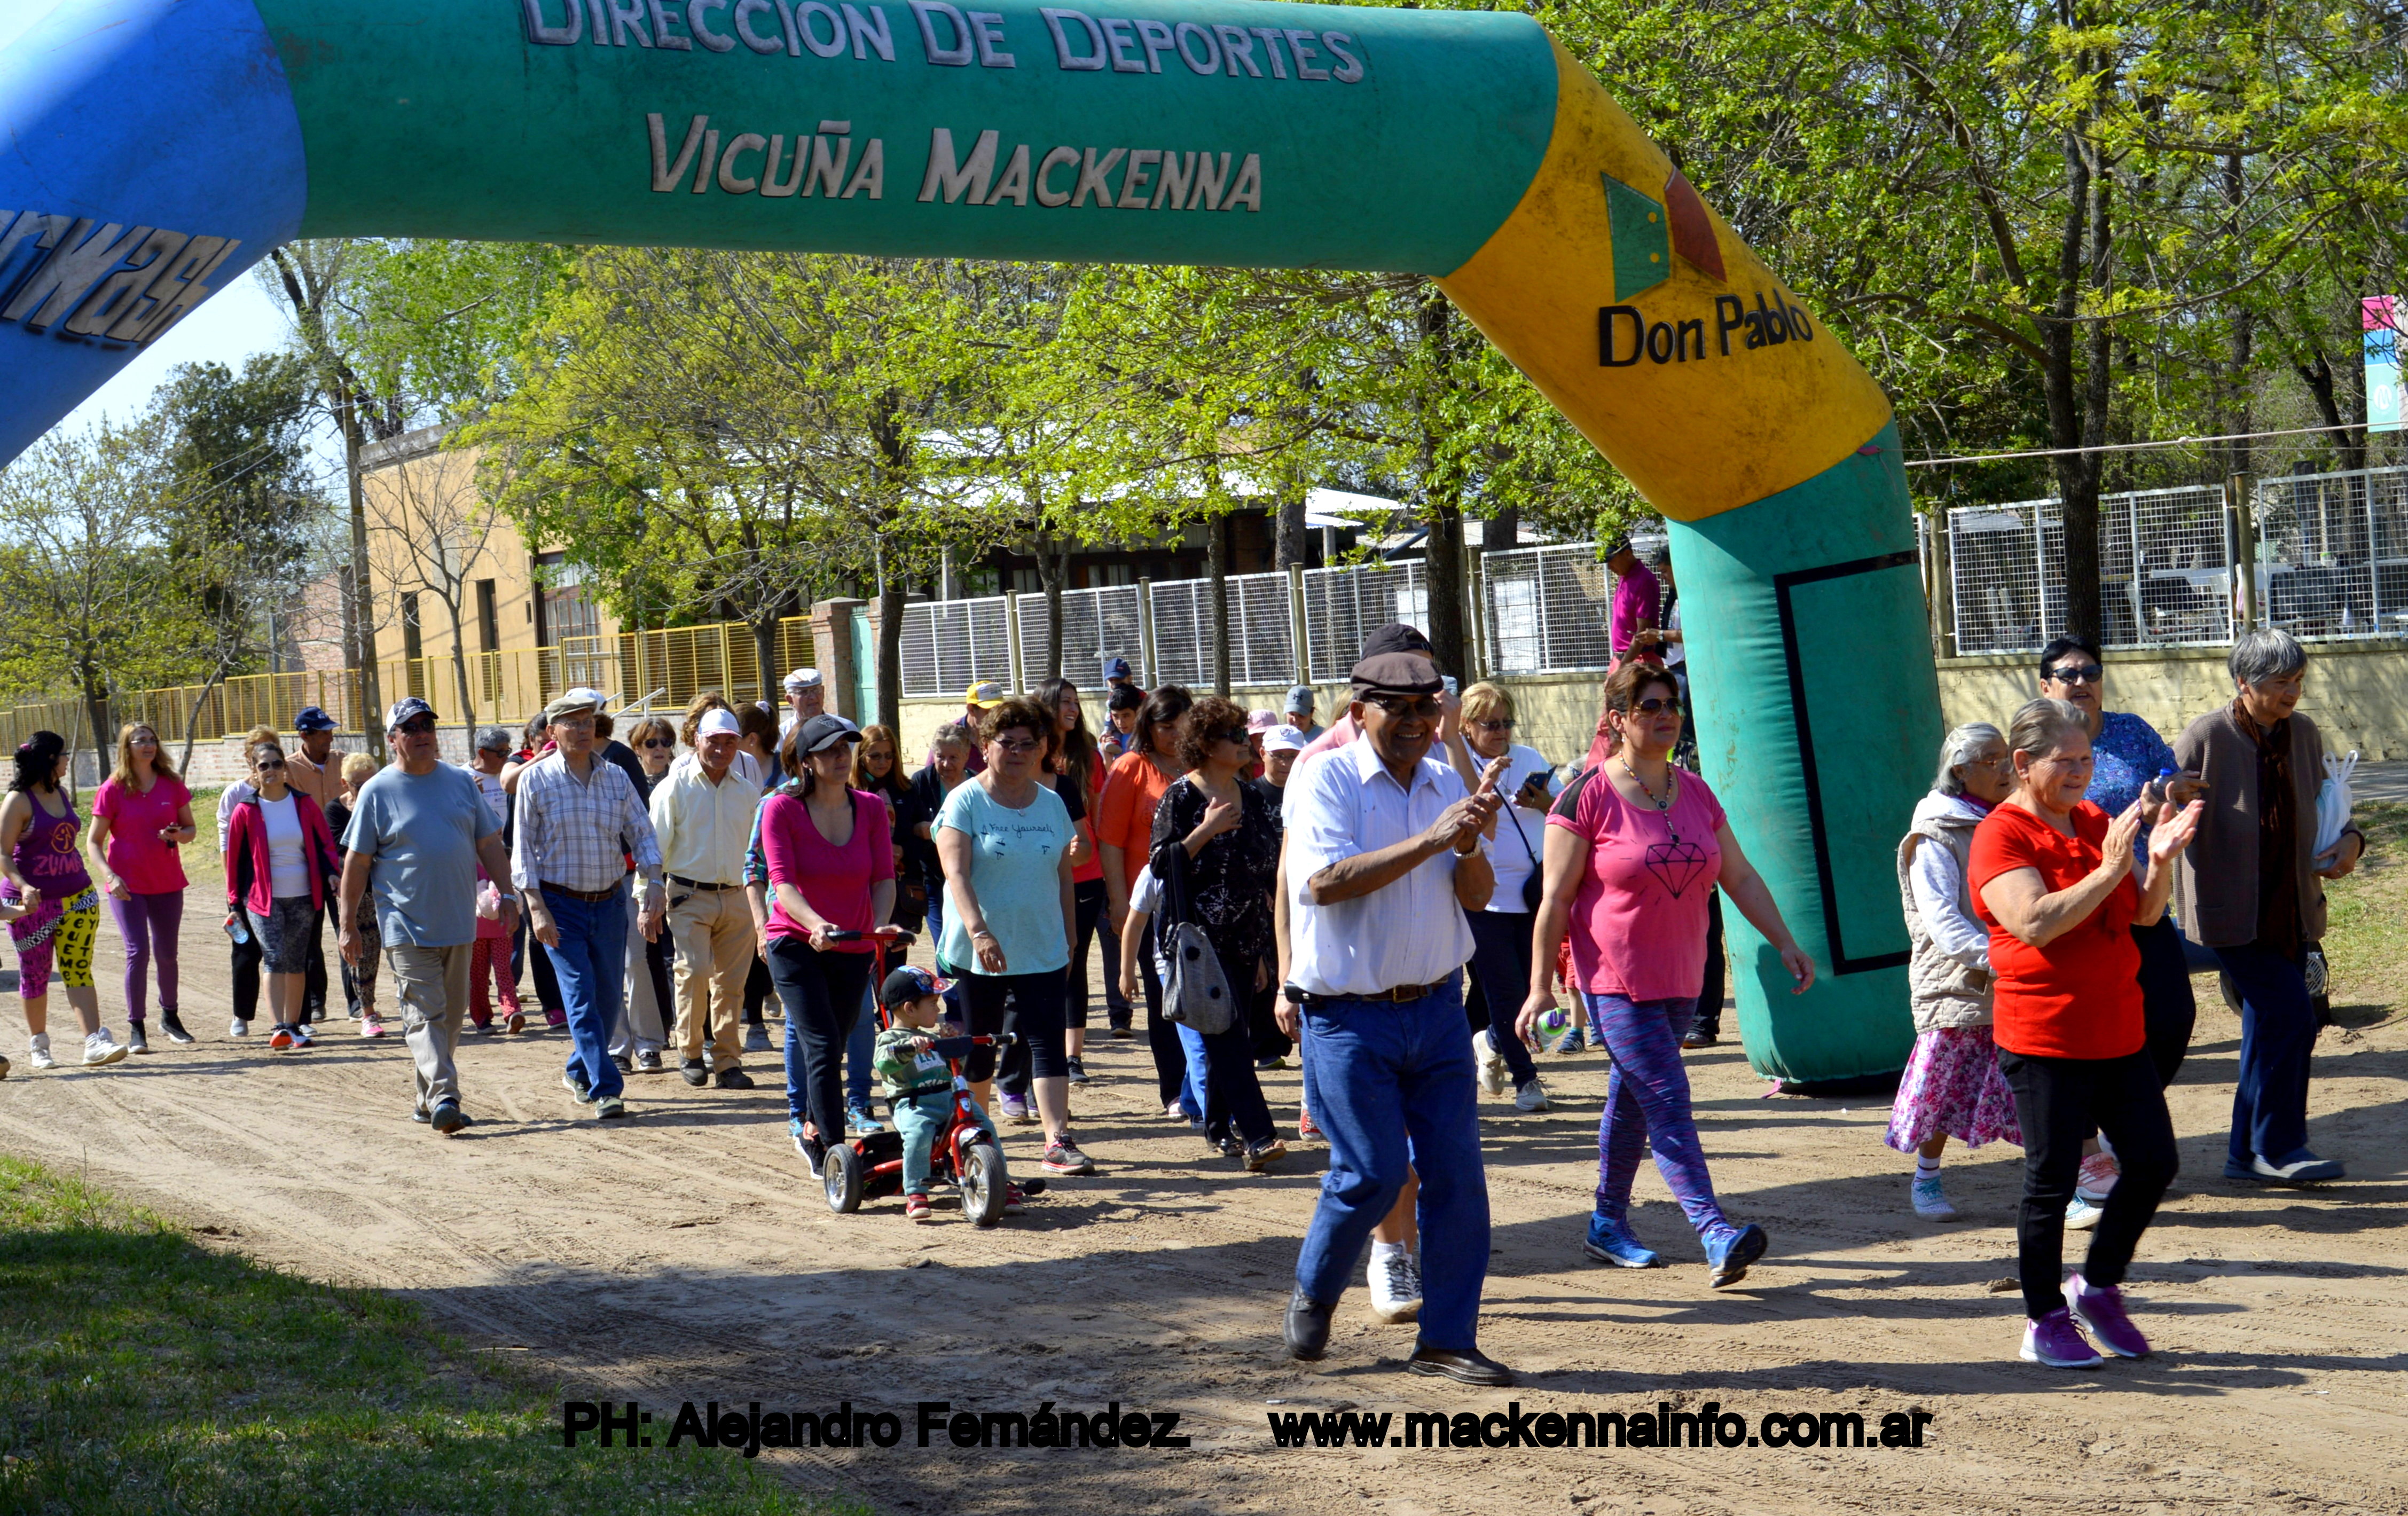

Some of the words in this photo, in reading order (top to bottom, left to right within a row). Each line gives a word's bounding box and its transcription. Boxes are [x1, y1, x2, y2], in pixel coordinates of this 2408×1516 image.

[908, 0, 1016, 68] DE
[1039, 7, 1364, 83] DEPORTES
[646, 112, 884, 200] VICUÑA
[916, 127, 1261, 212] MACKENNA
[1599, 305, 1706, 367] Don
[1714, 288, 1814, 357] Pablo
[989, 823, 1009, 832] Free
[1011, 824, 1055, 839] Yourself
